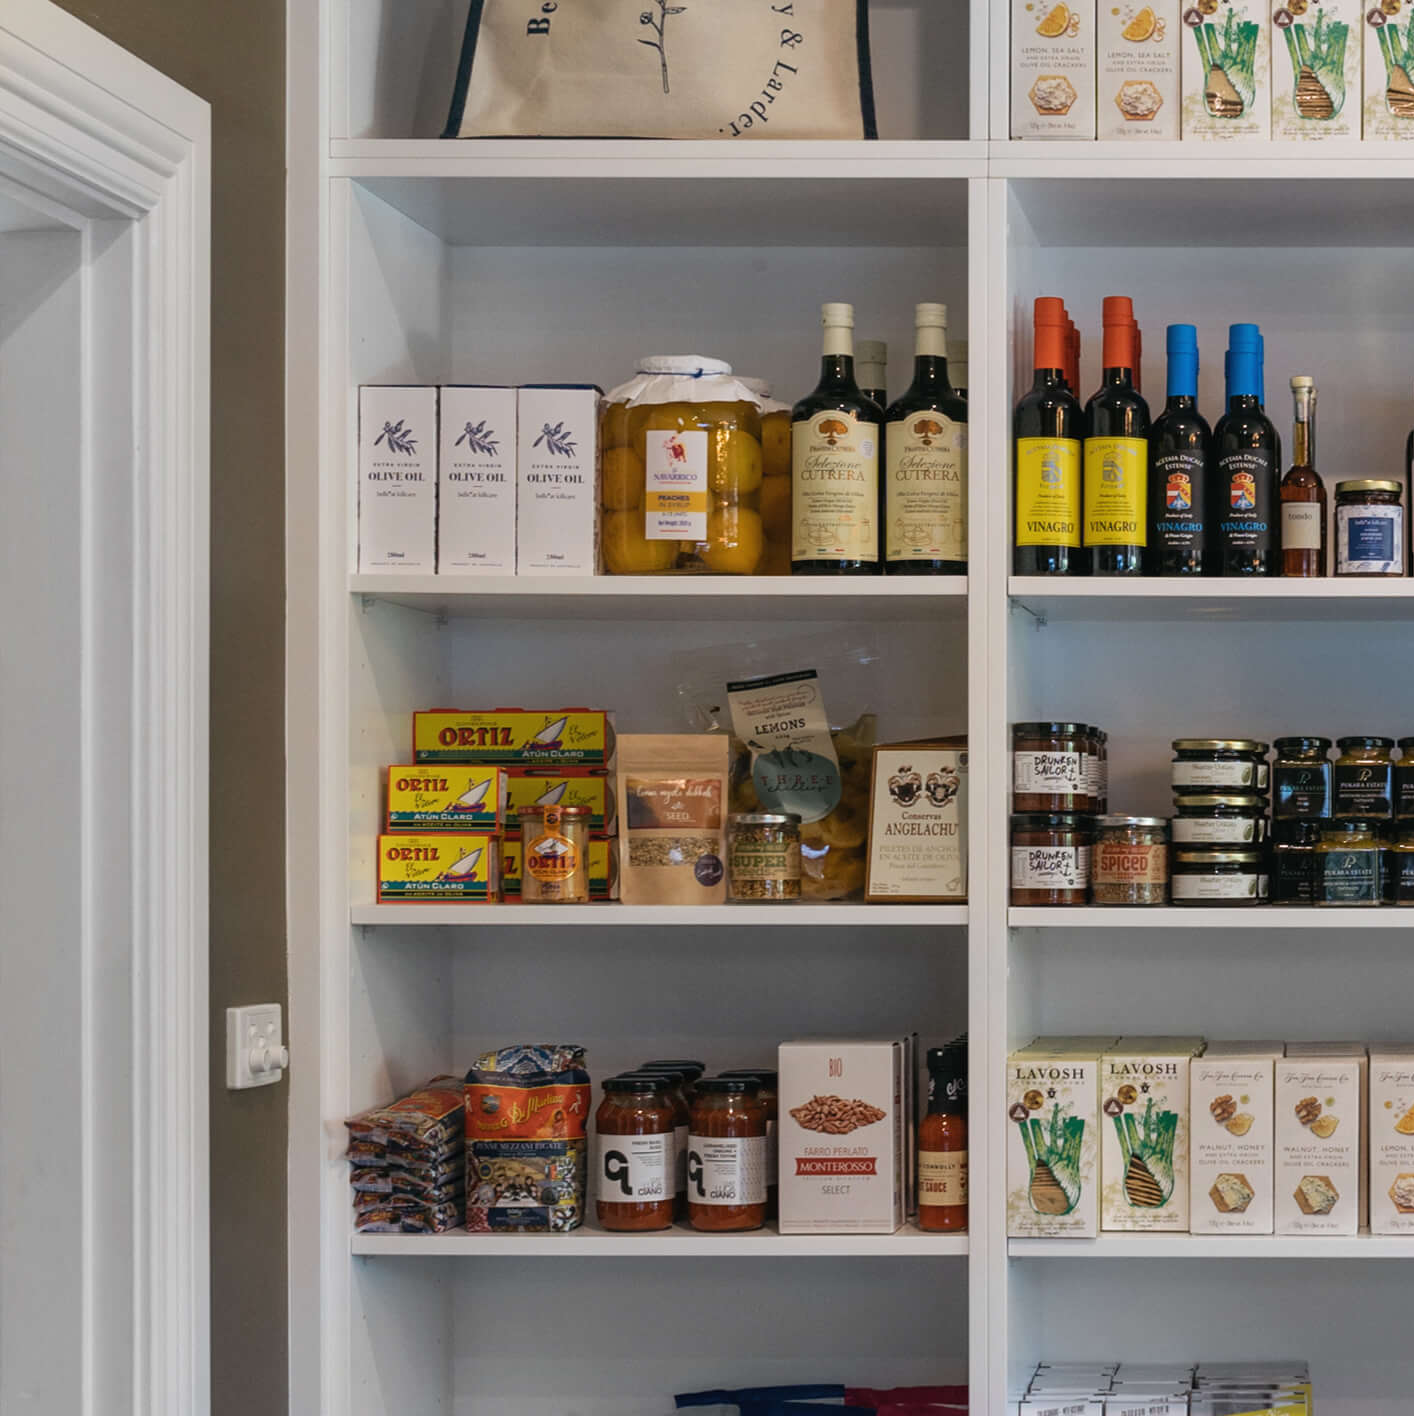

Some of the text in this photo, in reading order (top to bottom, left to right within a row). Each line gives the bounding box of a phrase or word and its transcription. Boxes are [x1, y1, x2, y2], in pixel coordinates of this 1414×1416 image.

[780, 28, 803, 49] &
[719, 59, 798, 137] Larder.
[368, 471, 425, 482] OLIVE OIL
[449, 472, 507, 482] OLIVE OIL
[527, 474, 584, 484] OLIVE OIL
[801, 469, 865, 482] CUTRERA
[896, 470, 960, 482] CUTRERA
[1026, 522, 1074, 534] VINAGRO
[1090, 522, 1136, 532] VINAGRO
[1156, 522, 1203, 531] VINAGRO
[1221, 522, 1267, 531] VINAGRO
[754, 718, 806, 736] LEMONS
[438, 727, 514, 747] ORTIZ
[522, 750, 584, 758] ATÚN CLARO
[1034, 756, 1077, 766] DRUNKEN
[1034, 765, 1068, 776] SAILOR
[396, 778, 448, 792] ORTIZ
[666, 812, 689, 820] SEED
[386, 847, 440, 862] ORTIZ
[1029, 852, 1073, 862] DRUNKEN
[528, 856, 576, 868] ORTIZ
[729, 855, 787, 868] SUPER
[1029, 862, 1062, 871] SAILOR
[404, 882, 464, 890] ATÚN CLARO
[829, 1058, 842, 1077] BIO
[1110, 1063, 1178, 1075] LAVOSH
[1016, 1068, 1084, 1080] LAVOSH
[804, 1148, 868, 1156] FARRO PERLATO
[800, 1161, 872, 1172] MONTEROSSO
[822, 1185, 851, 1194] SELECT
[926, 1182, 947, 1192] SAUCE
